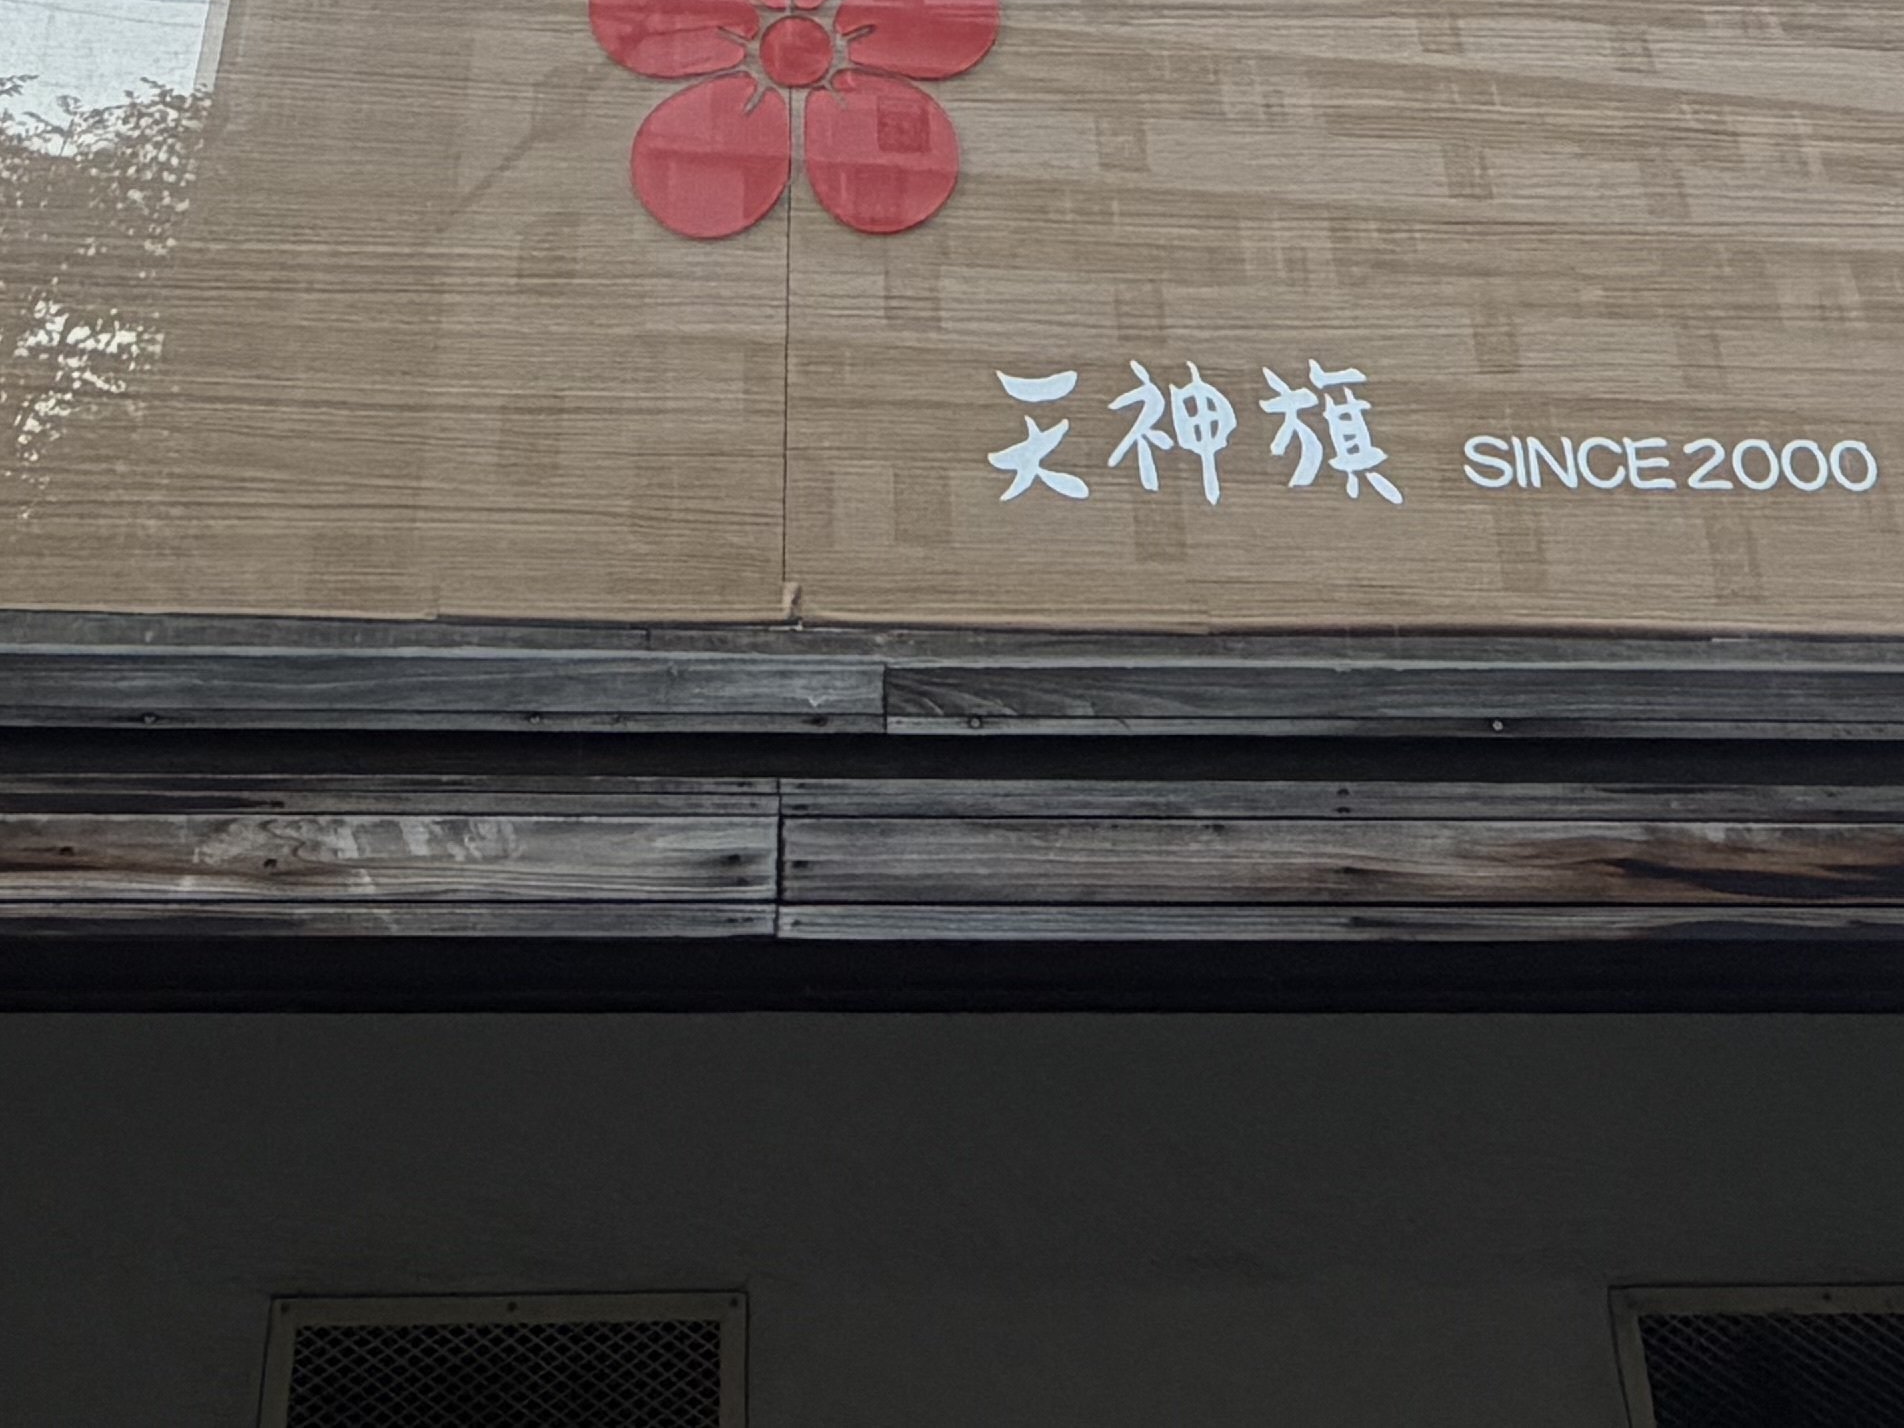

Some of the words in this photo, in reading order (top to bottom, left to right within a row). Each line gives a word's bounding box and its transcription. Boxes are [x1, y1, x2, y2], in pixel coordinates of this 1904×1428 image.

[988, 358, 1404, 506] 天神旗
[1463, 435, 1677, 490] SINCE
[1685, 438, 1879, 493] 2000
